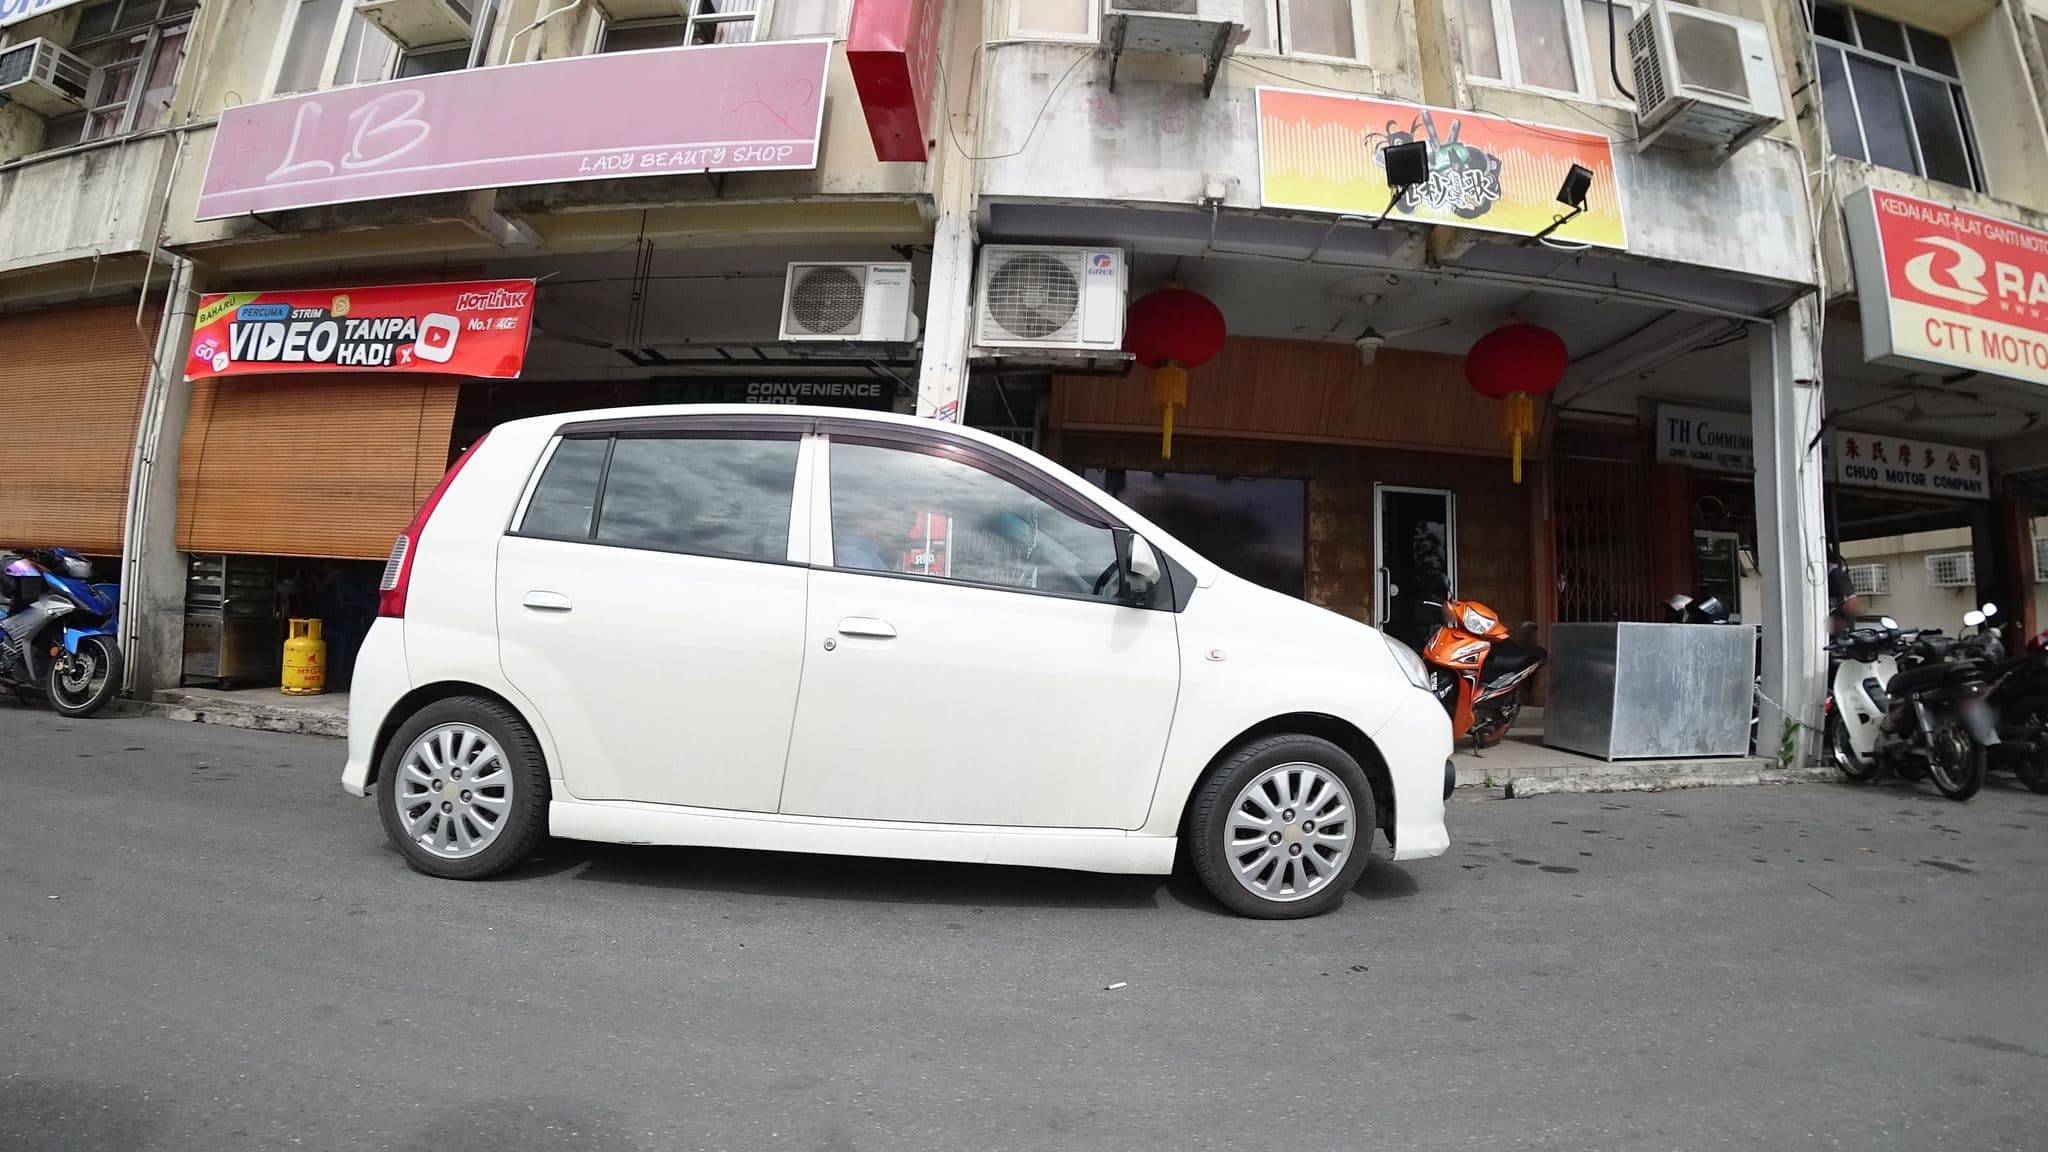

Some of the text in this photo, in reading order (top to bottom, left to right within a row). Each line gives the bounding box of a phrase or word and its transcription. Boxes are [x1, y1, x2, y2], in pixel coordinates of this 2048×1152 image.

[578, 145, 793, 172] LADY BEAUTY SHOP
[1879, 196, 1920, 217] KEDAI
[1921, 207, 1983, 236] ALAT-ALAT
[1984, 223, 2020, 248] GANTI
[200, 297, 236, 323] BAHARU
[242, 308, 324, 319] PERCUMA STRIM
[345, 317, 417, 341] TANPA
[467, 317, 493, 331] No.1
[195, 344, 214, 361] GO
[229, 320, 339, 363] VIDEO
[336, 343, 393, 366] HAD!
[1925, 318, 2048, 371] CTT MOTO
[747, 382, 881, 397] CONVENIENCE
[1667, 417, 1691, 444] TH
[1845, 464, 1984, 494] CHUO MOTOR COMPANY
